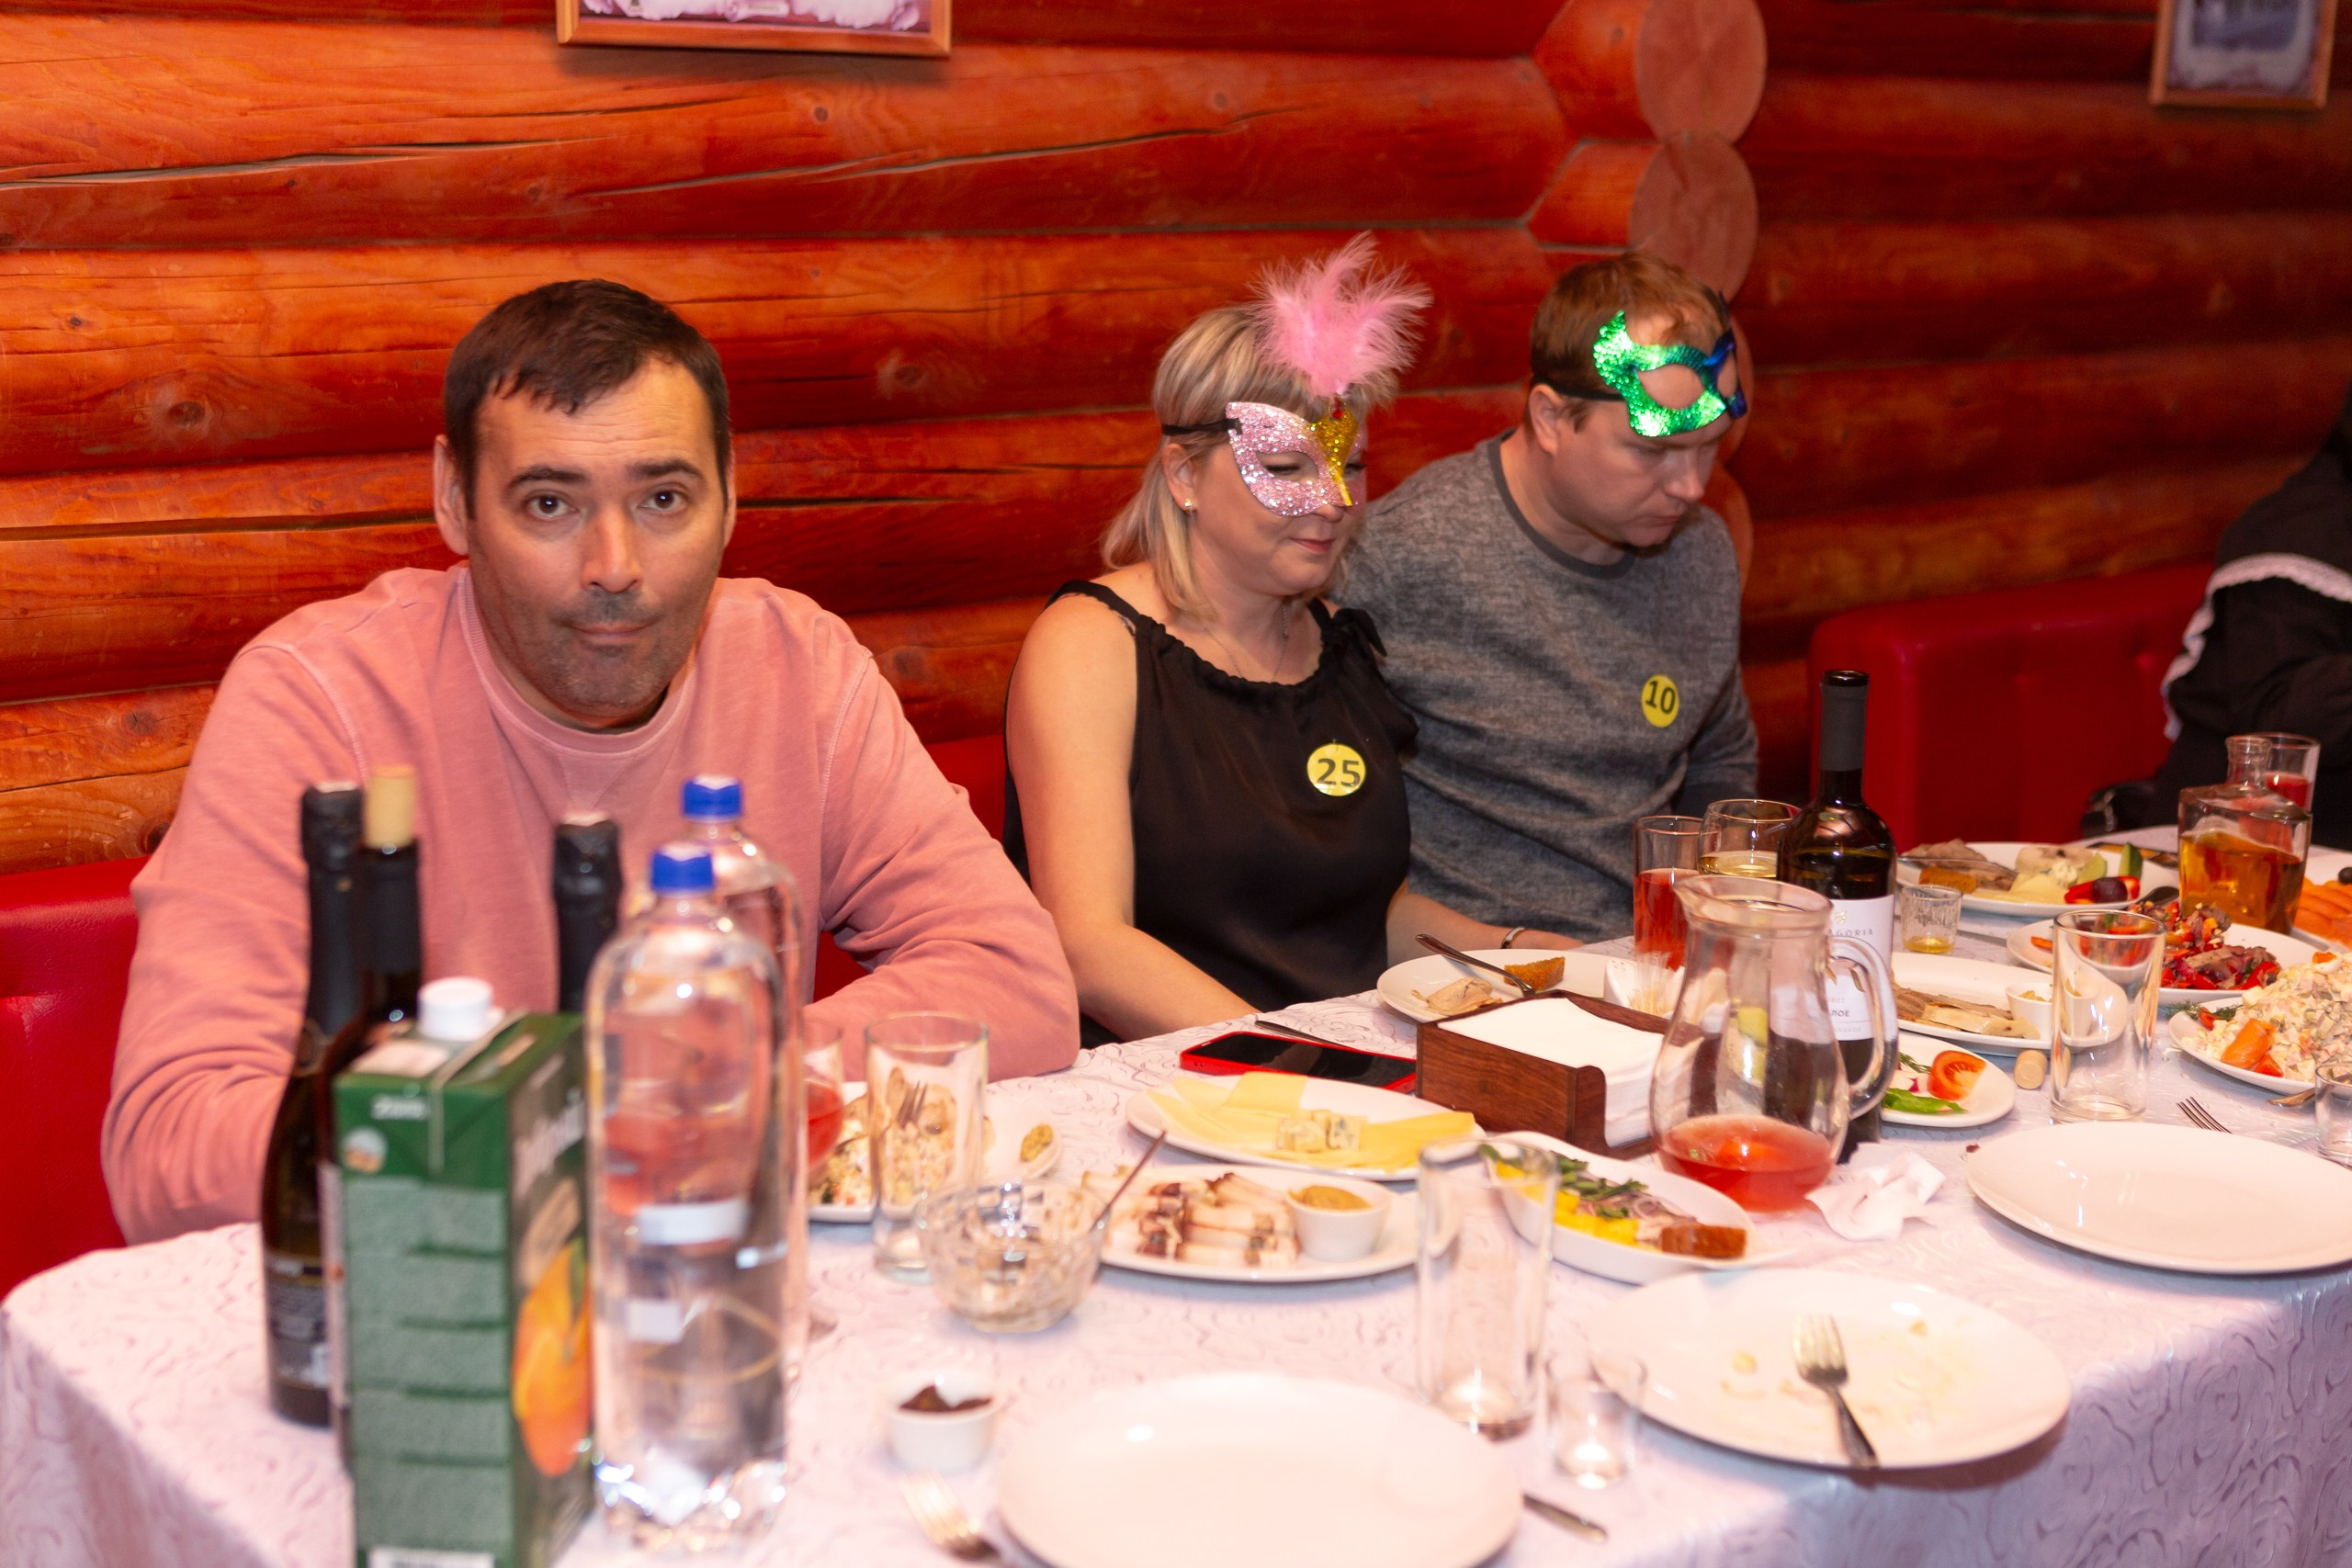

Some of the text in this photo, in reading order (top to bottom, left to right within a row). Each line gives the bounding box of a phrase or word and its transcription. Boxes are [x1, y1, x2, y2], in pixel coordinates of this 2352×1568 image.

[1645, 681, 1676, 715] 10
[1317, 758, 1361, 787] 25
[1827, 928, 1874, 938] AGORIA
[1830, 1010, 1850, 1018] ЛОЕ
